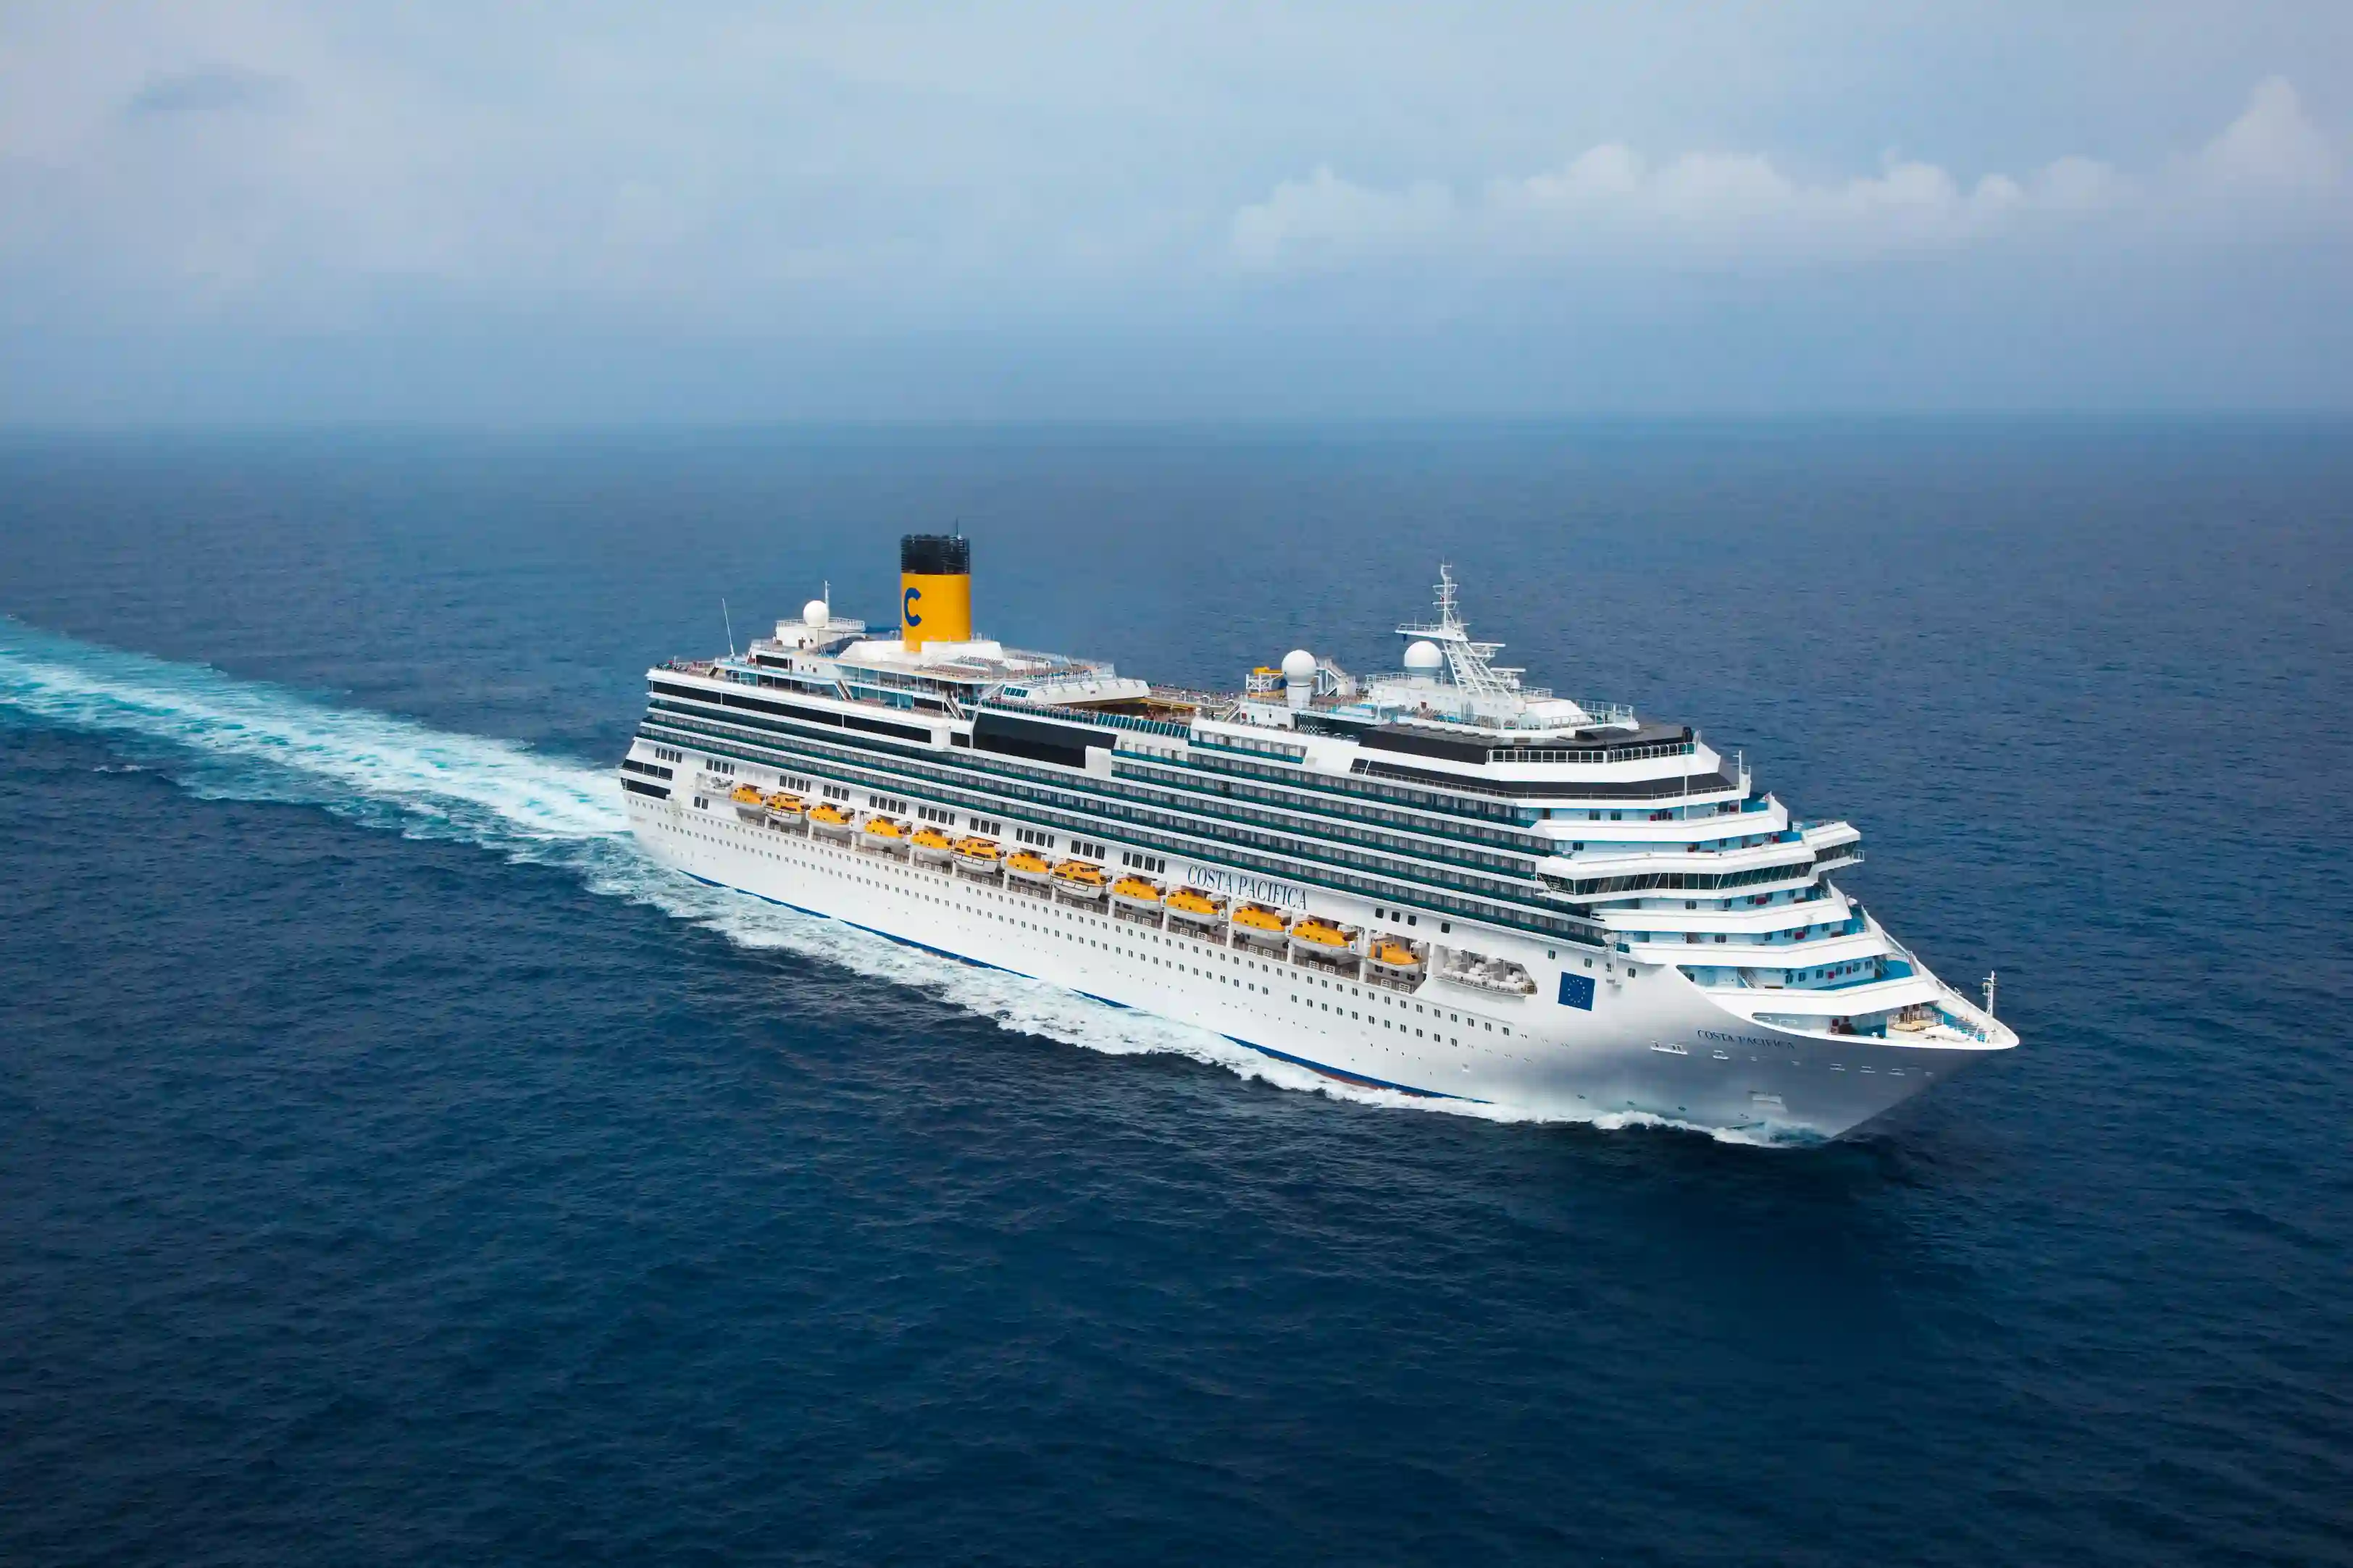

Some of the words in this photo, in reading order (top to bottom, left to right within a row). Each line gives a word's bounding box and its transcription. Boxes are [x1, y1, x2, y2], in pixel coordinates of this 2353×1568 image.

[904, 587, 922, 626] C
[1187, 865, 1233, 893] COSTA
[1237, 876, 1307, 910] PACIFICA
[1697, 1029, 1735, 1042] COSTA
